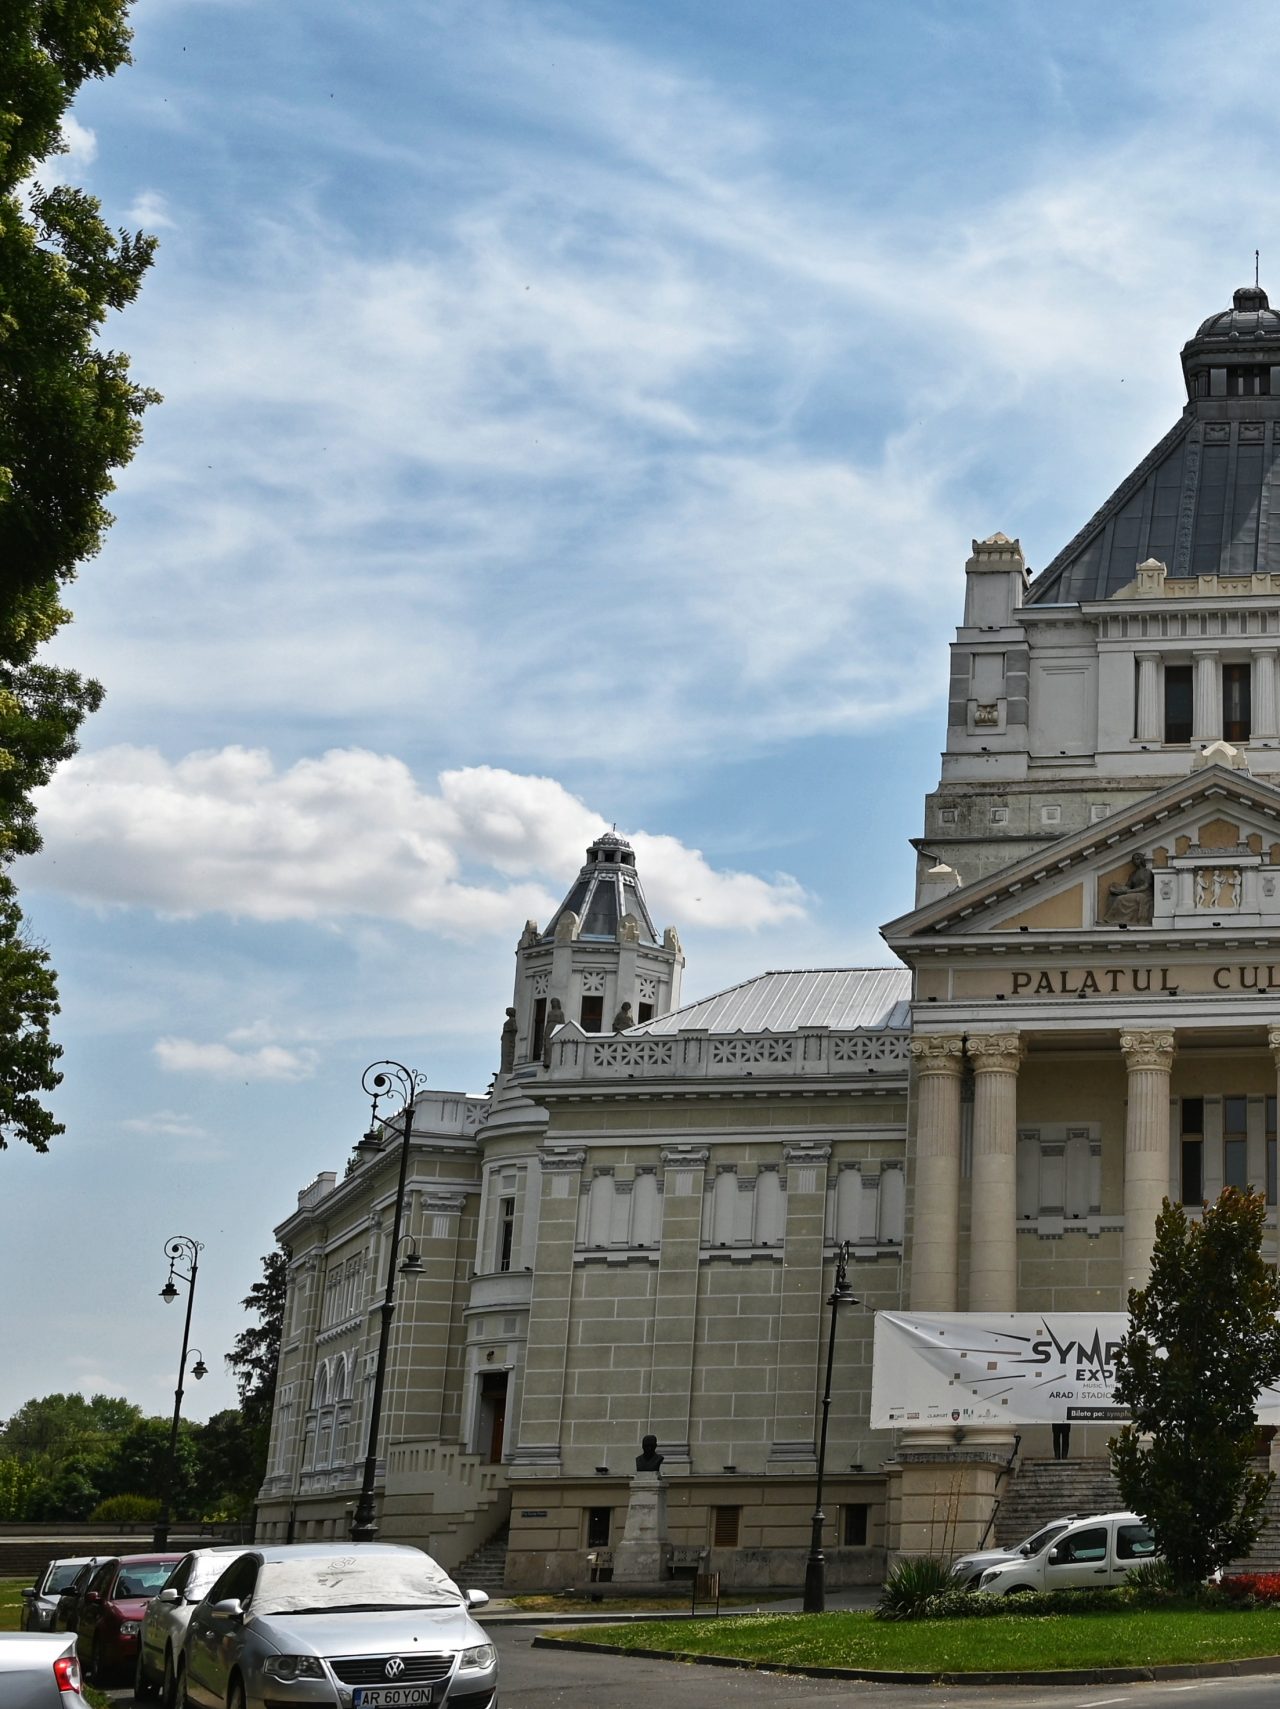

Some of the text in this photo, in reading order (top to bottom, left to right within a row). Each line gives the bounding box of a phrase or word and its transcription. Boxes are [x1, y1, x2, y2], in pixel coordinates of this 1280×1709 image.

[1011, 968, 1179, 994] PALATUL
[1076, 1368, 1119, 1381] EXP
[1049, 1391, 1112, 1399] ARAD STADIO
[1071, 1409, 1091, 1417] Bilete
[362, 1689, 431, 1705] AR 60 YON
